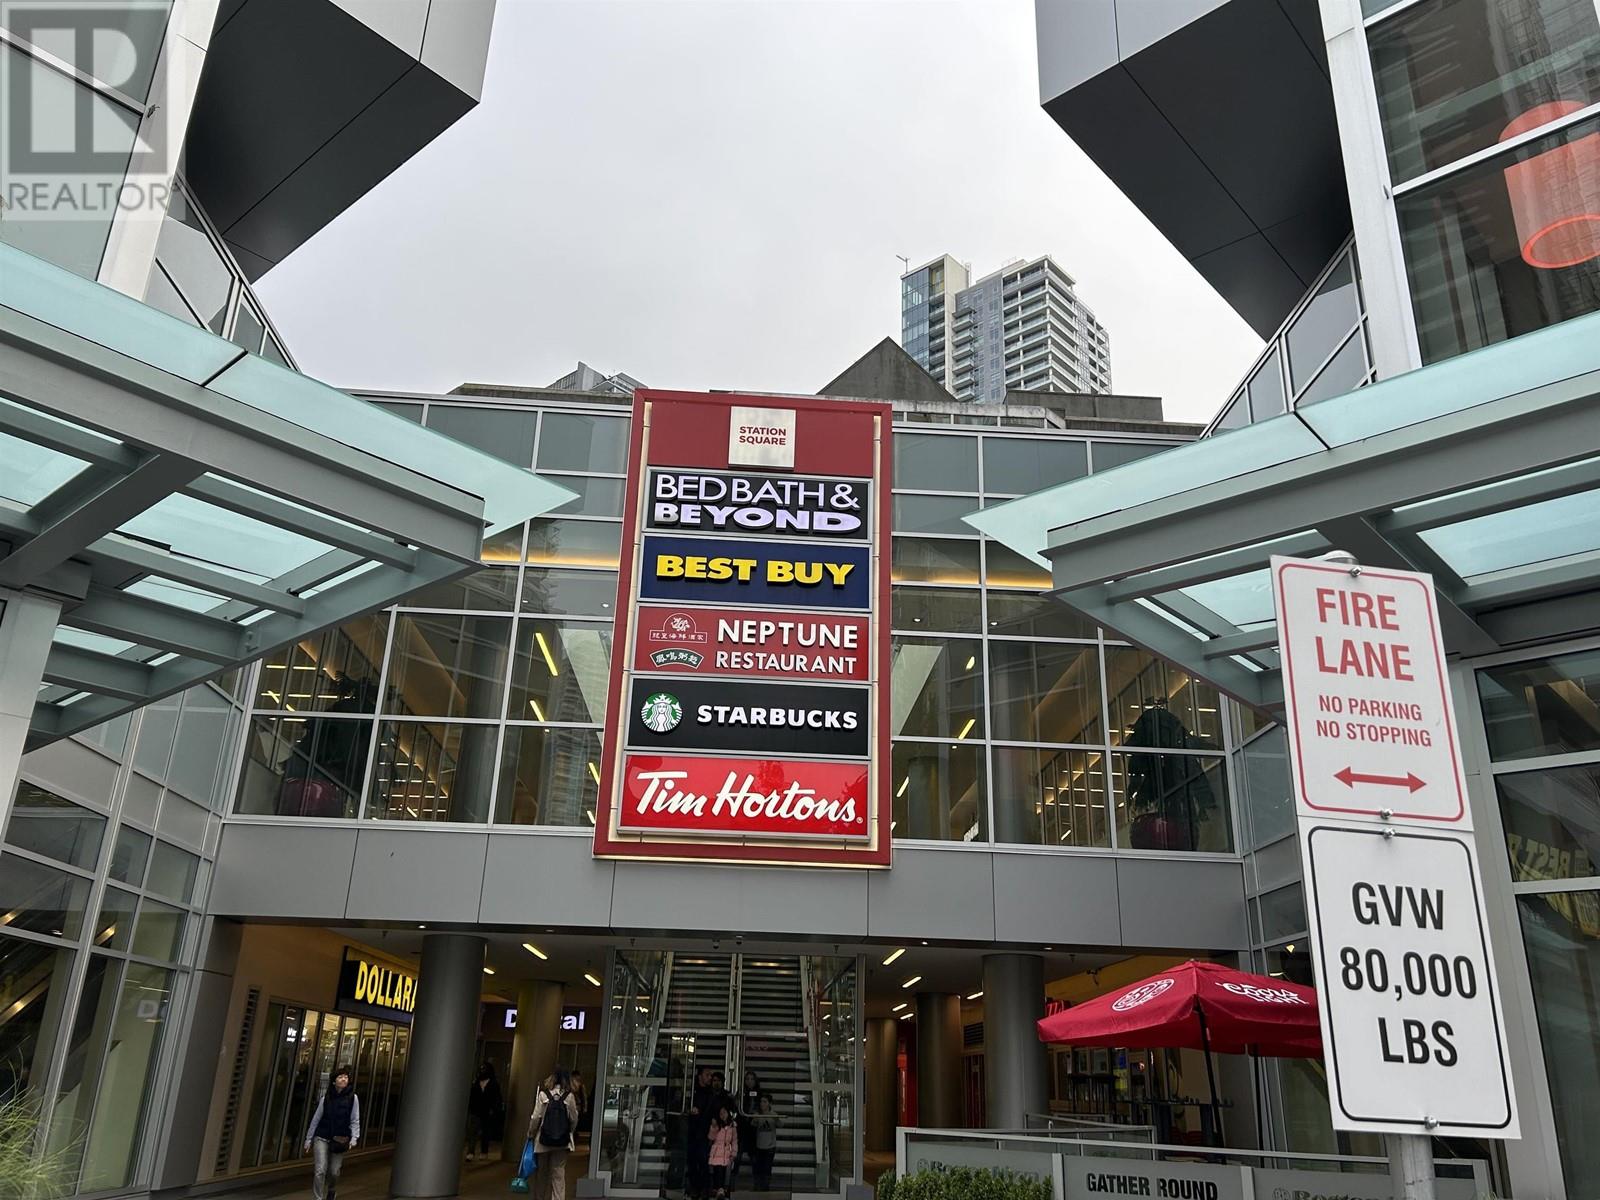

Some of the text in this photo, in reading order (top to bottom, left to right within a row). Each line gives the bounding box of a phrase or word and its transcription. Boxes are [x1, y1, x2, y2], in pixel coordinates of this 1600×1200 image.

[739, 426, 786, 437] STATION
[739, 435, 786, 446] SQUARE
[656, 474, 860, 509] BED BATH &
[654, 503, 862, 532] BEYOND
[656, 554, 855, 585] BEST BUY
[1316, 588, 1400, 631] FIRE
[717, 619, 858, 648] NEPTUNE
[715, 651, 857, 674] RESTAURANT
[1315, 636, 1414, 682] LANE
[697, 704, 858, 730] STARBUCKS
[1319, 695, 1422, 721] NO PARKING
[1316, 720, 1432, 747] NO STOPPING
[636, 771, 708, 816] Tim
[1352, 882, 1443, 930] GVW
[1340, 946, 1477, 1002] 80,000
[1377, 1017, 1458, 1067] LBS
[1087, 1172, 1219, 1200] GATHER ROUND
